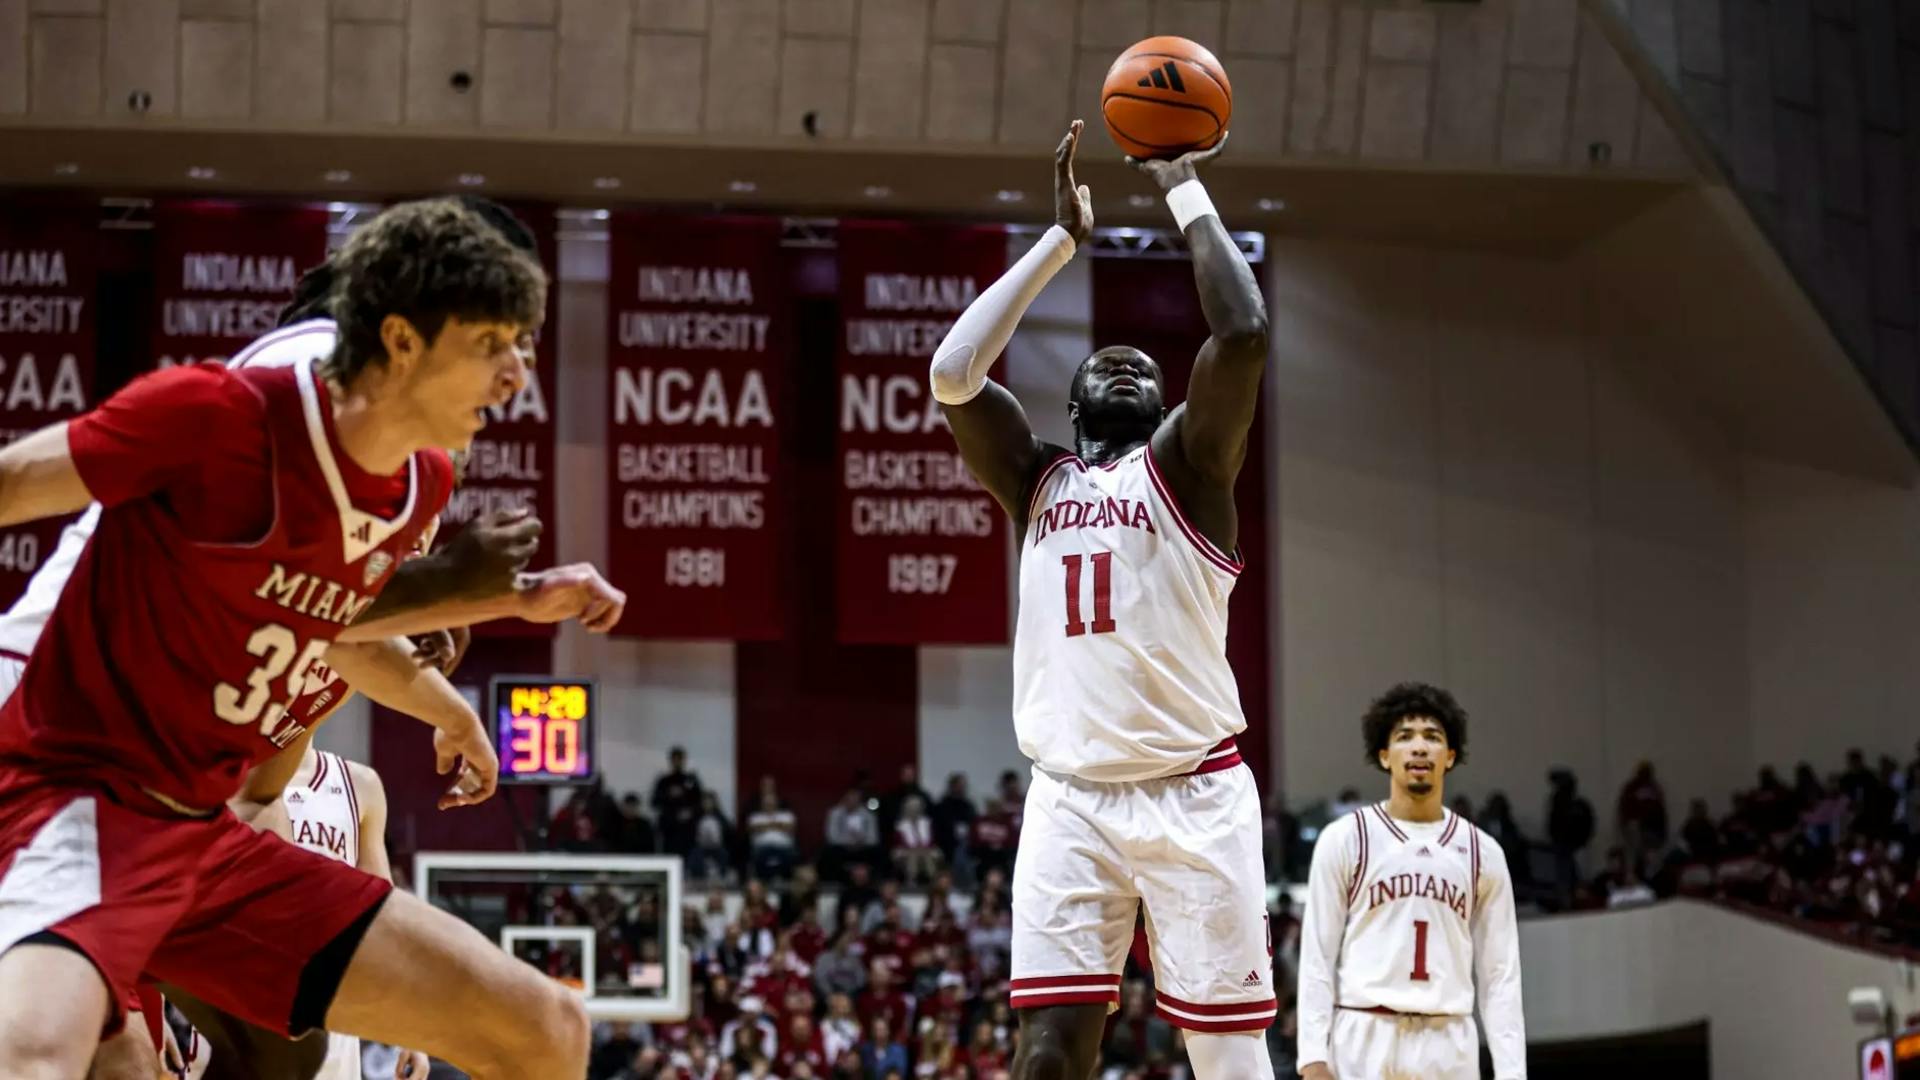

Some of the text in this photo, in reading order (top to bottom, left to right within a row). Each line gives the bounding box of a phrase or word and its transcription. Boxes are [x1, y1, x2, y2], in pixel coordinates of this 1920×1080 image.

[183, 254, 296, 291] INDIANA
[638, 266, 752, 303] INDIANA
[865, 274, 977, 310] INDIANA
[619, 310, 770, 350] UNIVERSITY
[615, 368, 774, 427] NCAA
[617, 443, 769, 483] BASKETBALL
[623, 489, 764, 529] CHAMPIONS
[852, 496, 992, 537] CHAMPIONS
[1034, 496, 1156, 548] INDIANA
[665, 547, 725, 587] 1981
[887, 553, 957, 594] 1987
[1061, 551, 1116, 637] 11
[511, 717, 577, 773] 30
[1368, 873, 1467, 921] INDIANA
[1410, 920, 1430, 982] 1
